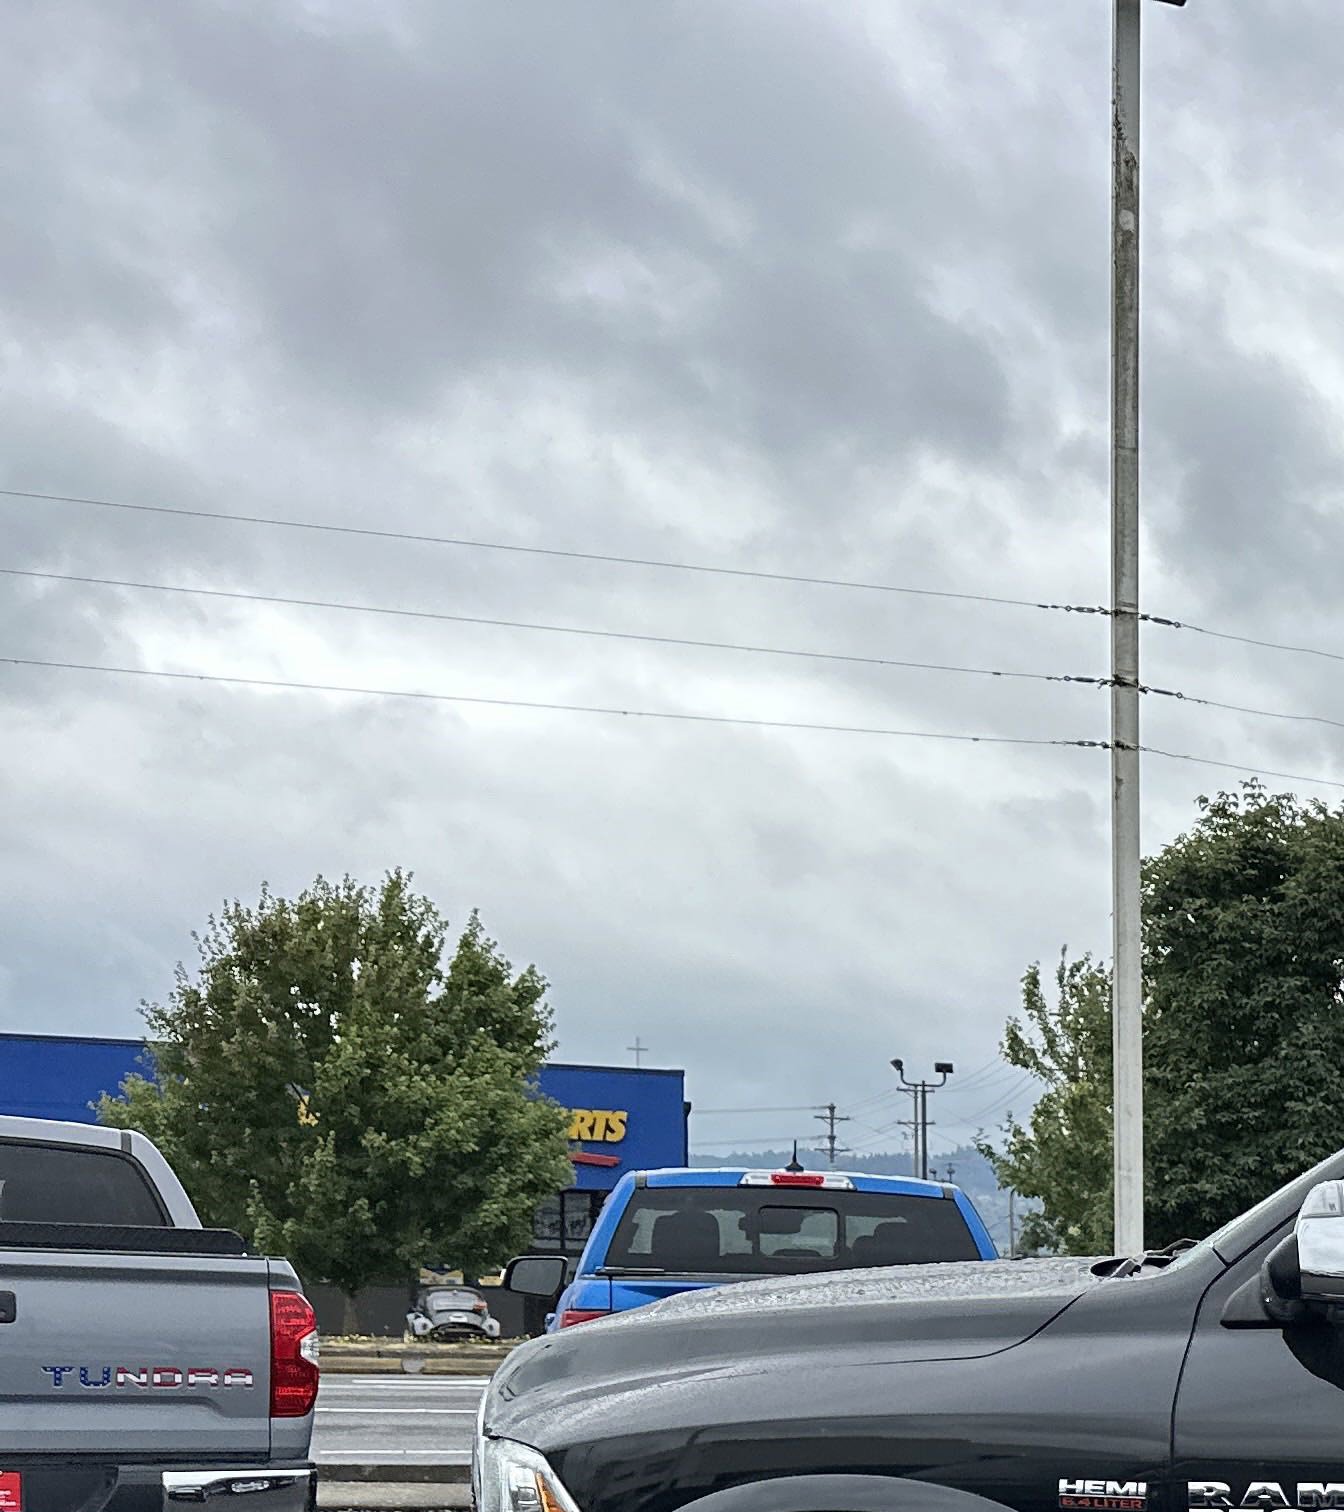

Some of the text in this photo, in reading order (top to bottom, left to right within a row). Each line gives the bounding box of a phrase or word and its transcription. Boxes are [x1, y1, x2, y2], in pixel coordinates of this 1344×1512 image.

[566, 1108, 628, 1142] RTS
[41, 1366, 254, 1389] TUNDRA
[1058, 1478, 1147, 1496] HEMI
[1061, 1498, 1143, 1509] 6.4 LITER
